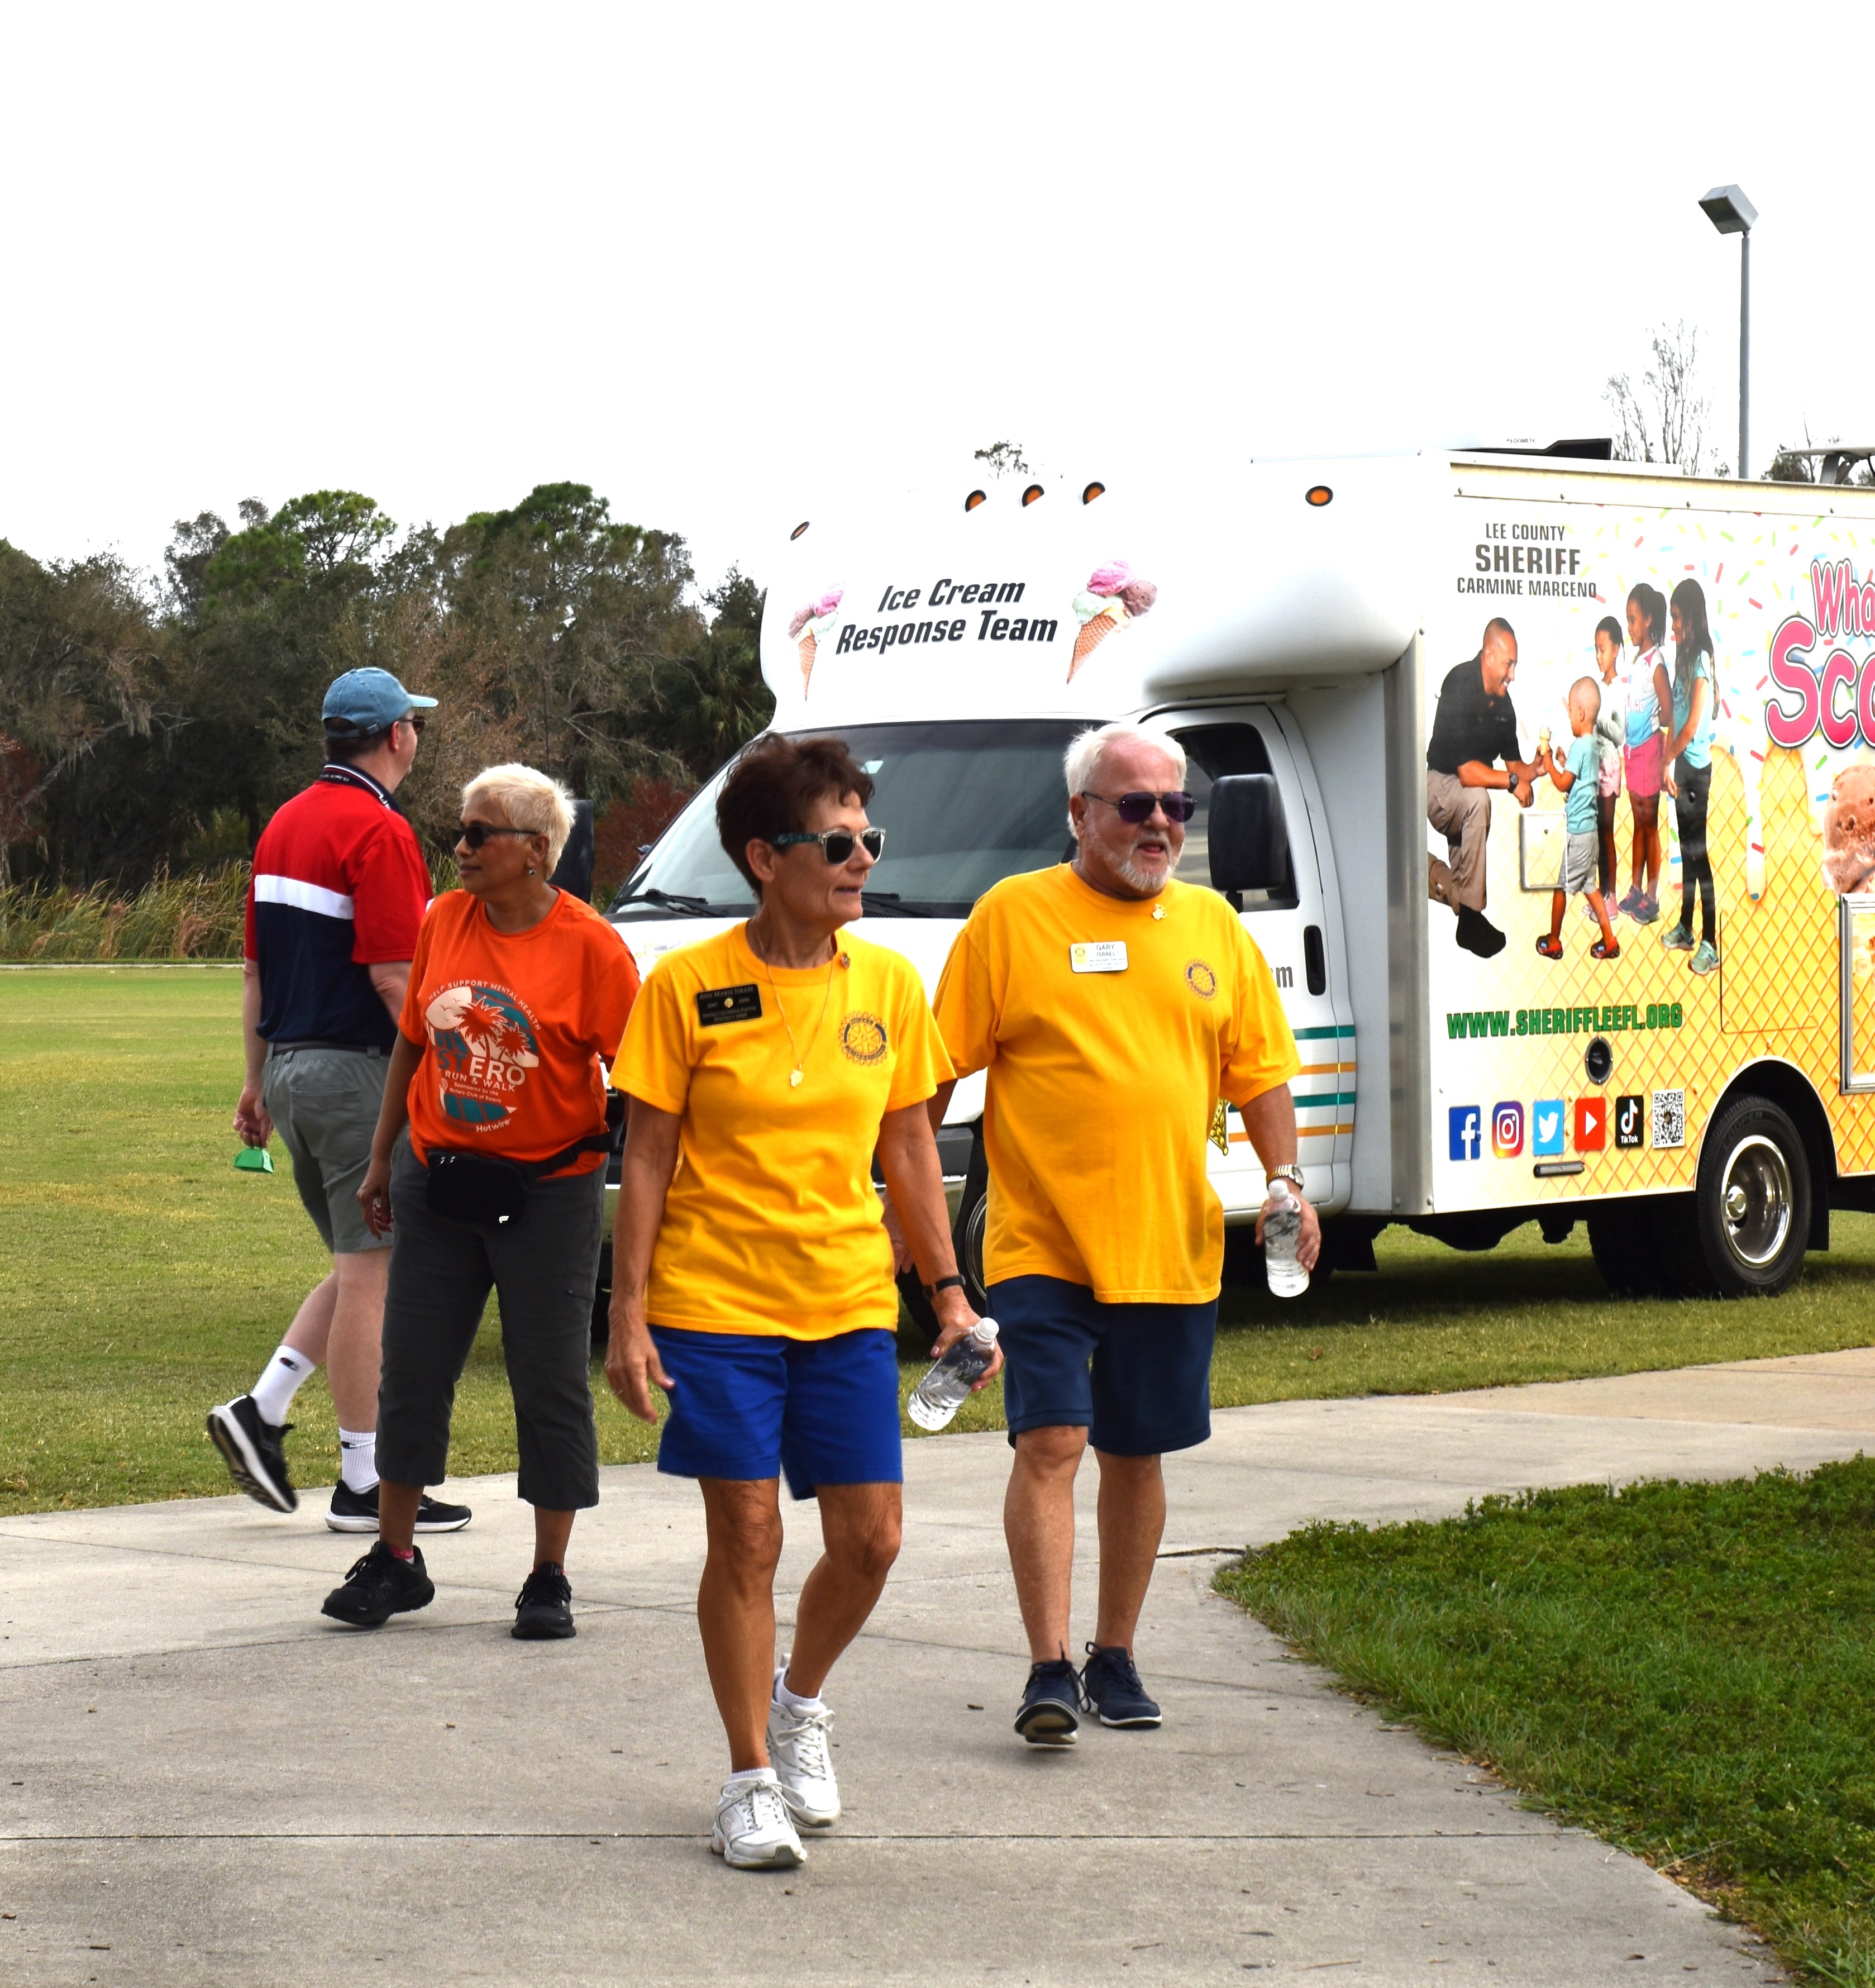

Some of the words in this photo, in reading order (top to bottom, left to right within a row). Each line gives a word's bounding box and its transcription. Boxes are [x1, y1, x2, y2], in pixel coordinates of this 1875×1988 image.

[1486, 523, 1507, 540] LEE
[1512, 524, 1565, 541] COUNTY
[1475, 544, 1581, 575] SHERIFF
[878, 584, 920, 613] Ice
[928, 578, 1026, 607] Cream
[1457, 577, 1523, 595] CARMINE
[1529, 580, 1596, 598] MARCENO
[836, 618, 966, 655] Response
[977, 610, 1058, 642] Team
[428, 985, 445, 1002] HELP
[448, 980, 489, 989] SUPPORT
[490, 983, 518, 1001] MENTAL
[518, 1000, 542, 1032] HEALTH
[1446, 1003, 1683, 1040] WWW.SHERIFFLEEFL.ORG
[445, 1070, 467, 1083] RUN
[471, 1077, 479, 1085] &
[483, 1079, 516, 1093] WALK
[449, 1088, 466, 1096] Rotary
[454, 1082, 481, 1093] Sponsored
[476, 1118, 510, 1133] Hotwire
[1620, 1134, 1639, 1145] TikTok
